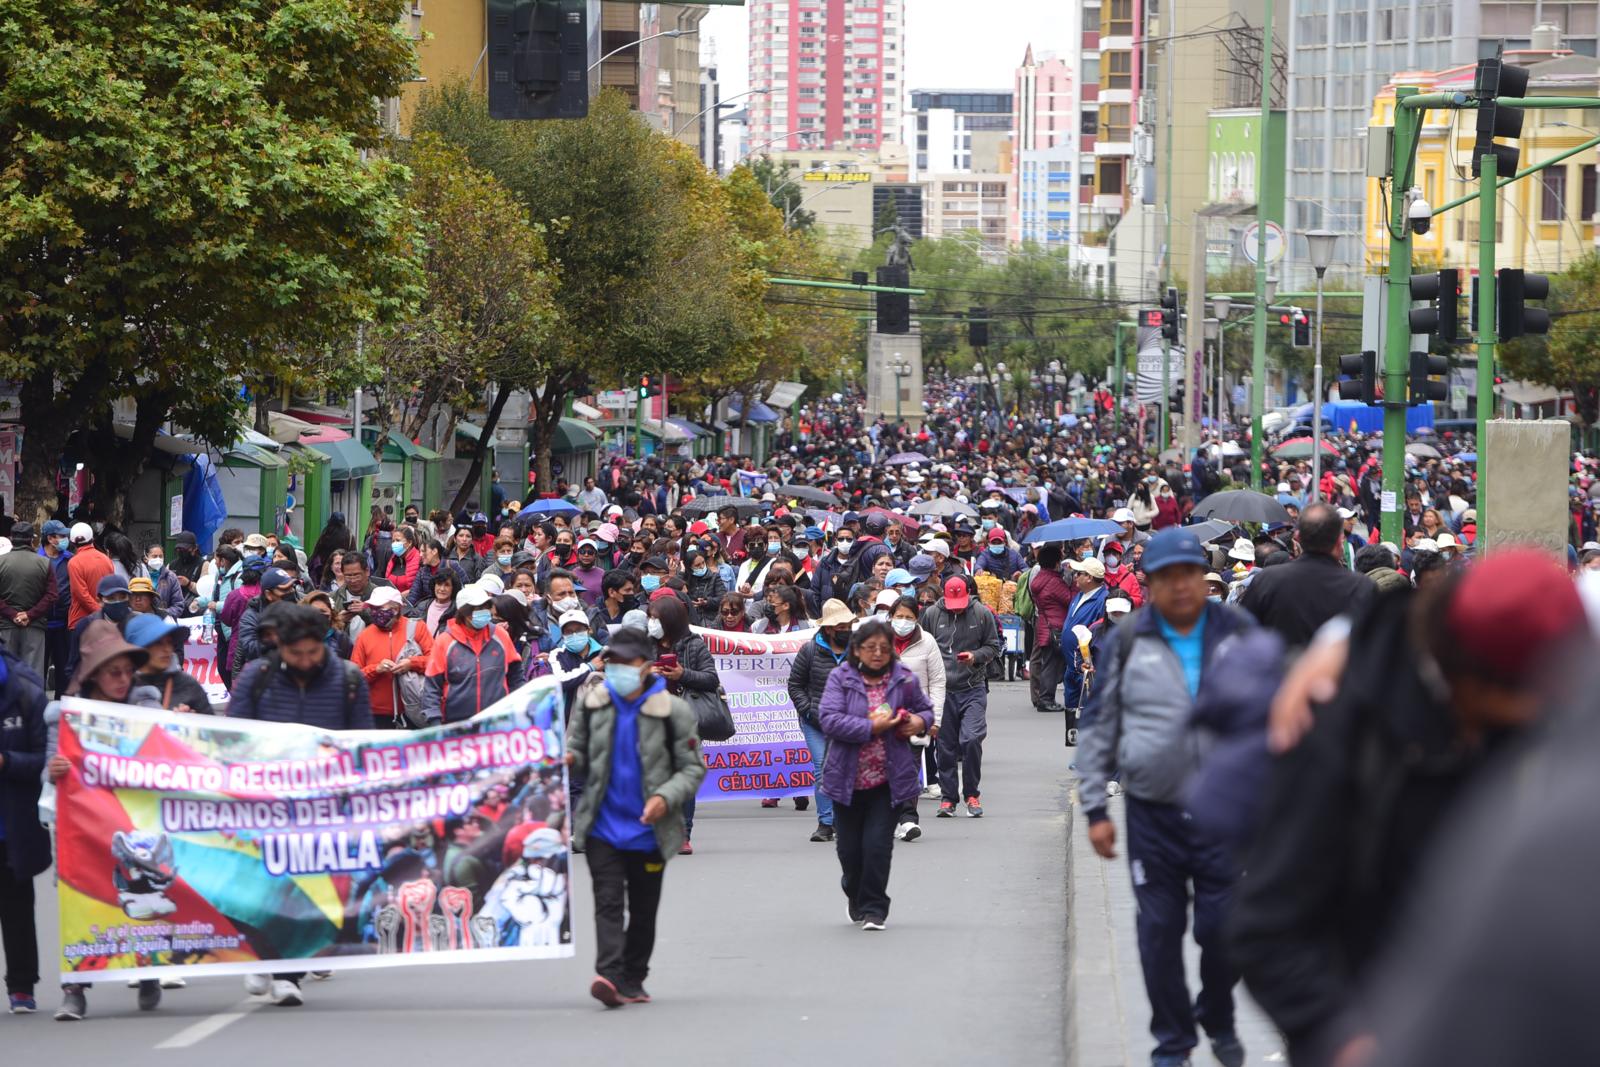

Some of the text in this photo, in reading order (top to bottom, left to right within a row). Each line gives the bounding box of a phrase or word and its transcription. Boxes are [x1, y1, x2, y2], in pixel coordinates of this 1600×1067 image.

[719, 656, 794, 671] BERTA
[728, 690, 788, 708] TURNO
[732, 711, 753, 722] CIAL
[772, 709, 797, 720] FAMI
[735, 720, 798, 732] MARIA COMU
[82, 728, 544, 791] SINDICATO REGIONAL DE MAESTROS
[704, 752, 727, 769] LA
[729, 750, 763, 768] PAZ
[718, 771, 816, 792] CÉLULA SIN
[162, 784, 471, 832] URBANOS DEL DISTRITO
[264, 829, 382, 874] UMALA
[117, 923, 129, 937] el
[174, 919, 215, 935] andino
